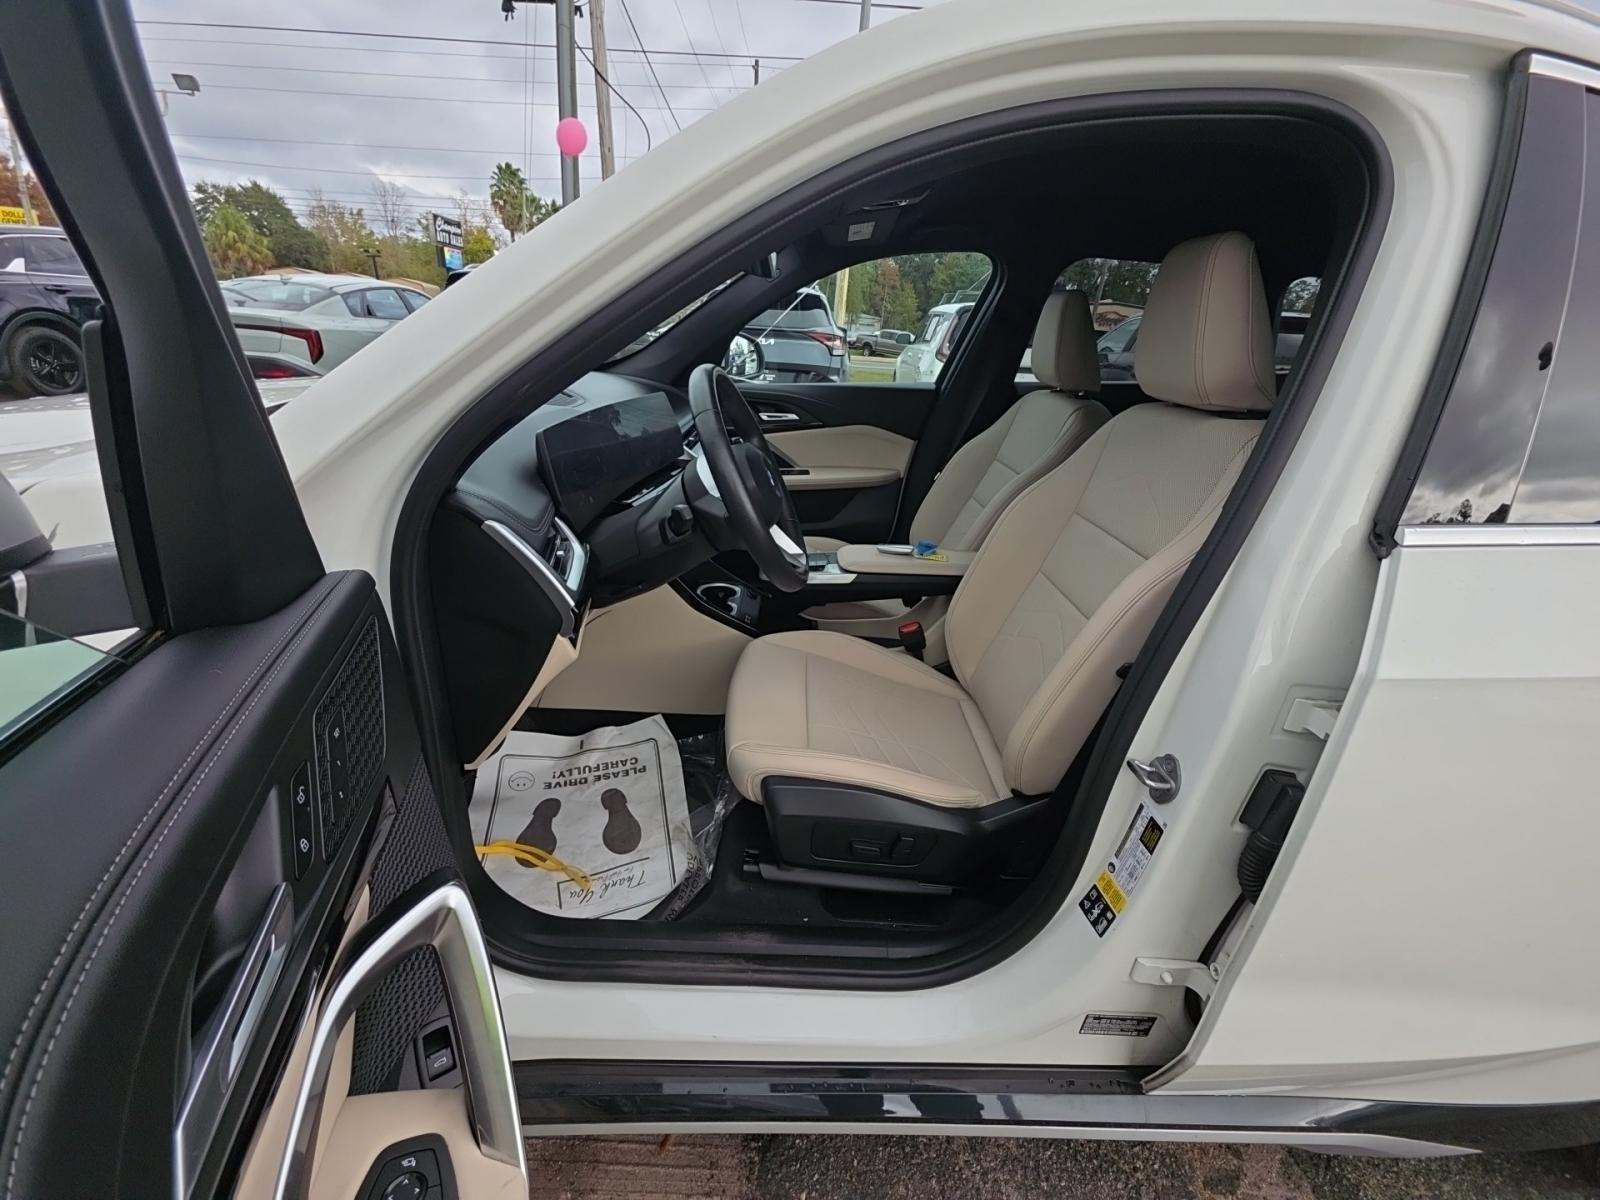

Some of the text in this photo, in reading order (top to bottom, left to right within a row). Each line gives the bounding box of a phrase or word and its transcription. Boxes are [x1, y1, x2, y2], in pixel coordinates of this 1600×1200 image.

[543, 765, 647, 790] PLEASE DRIVE
[552, 756, 639, 779] CAREFULLY!
[599, 870, 646, 899] Thank
[569, 888, 594, 906] You
